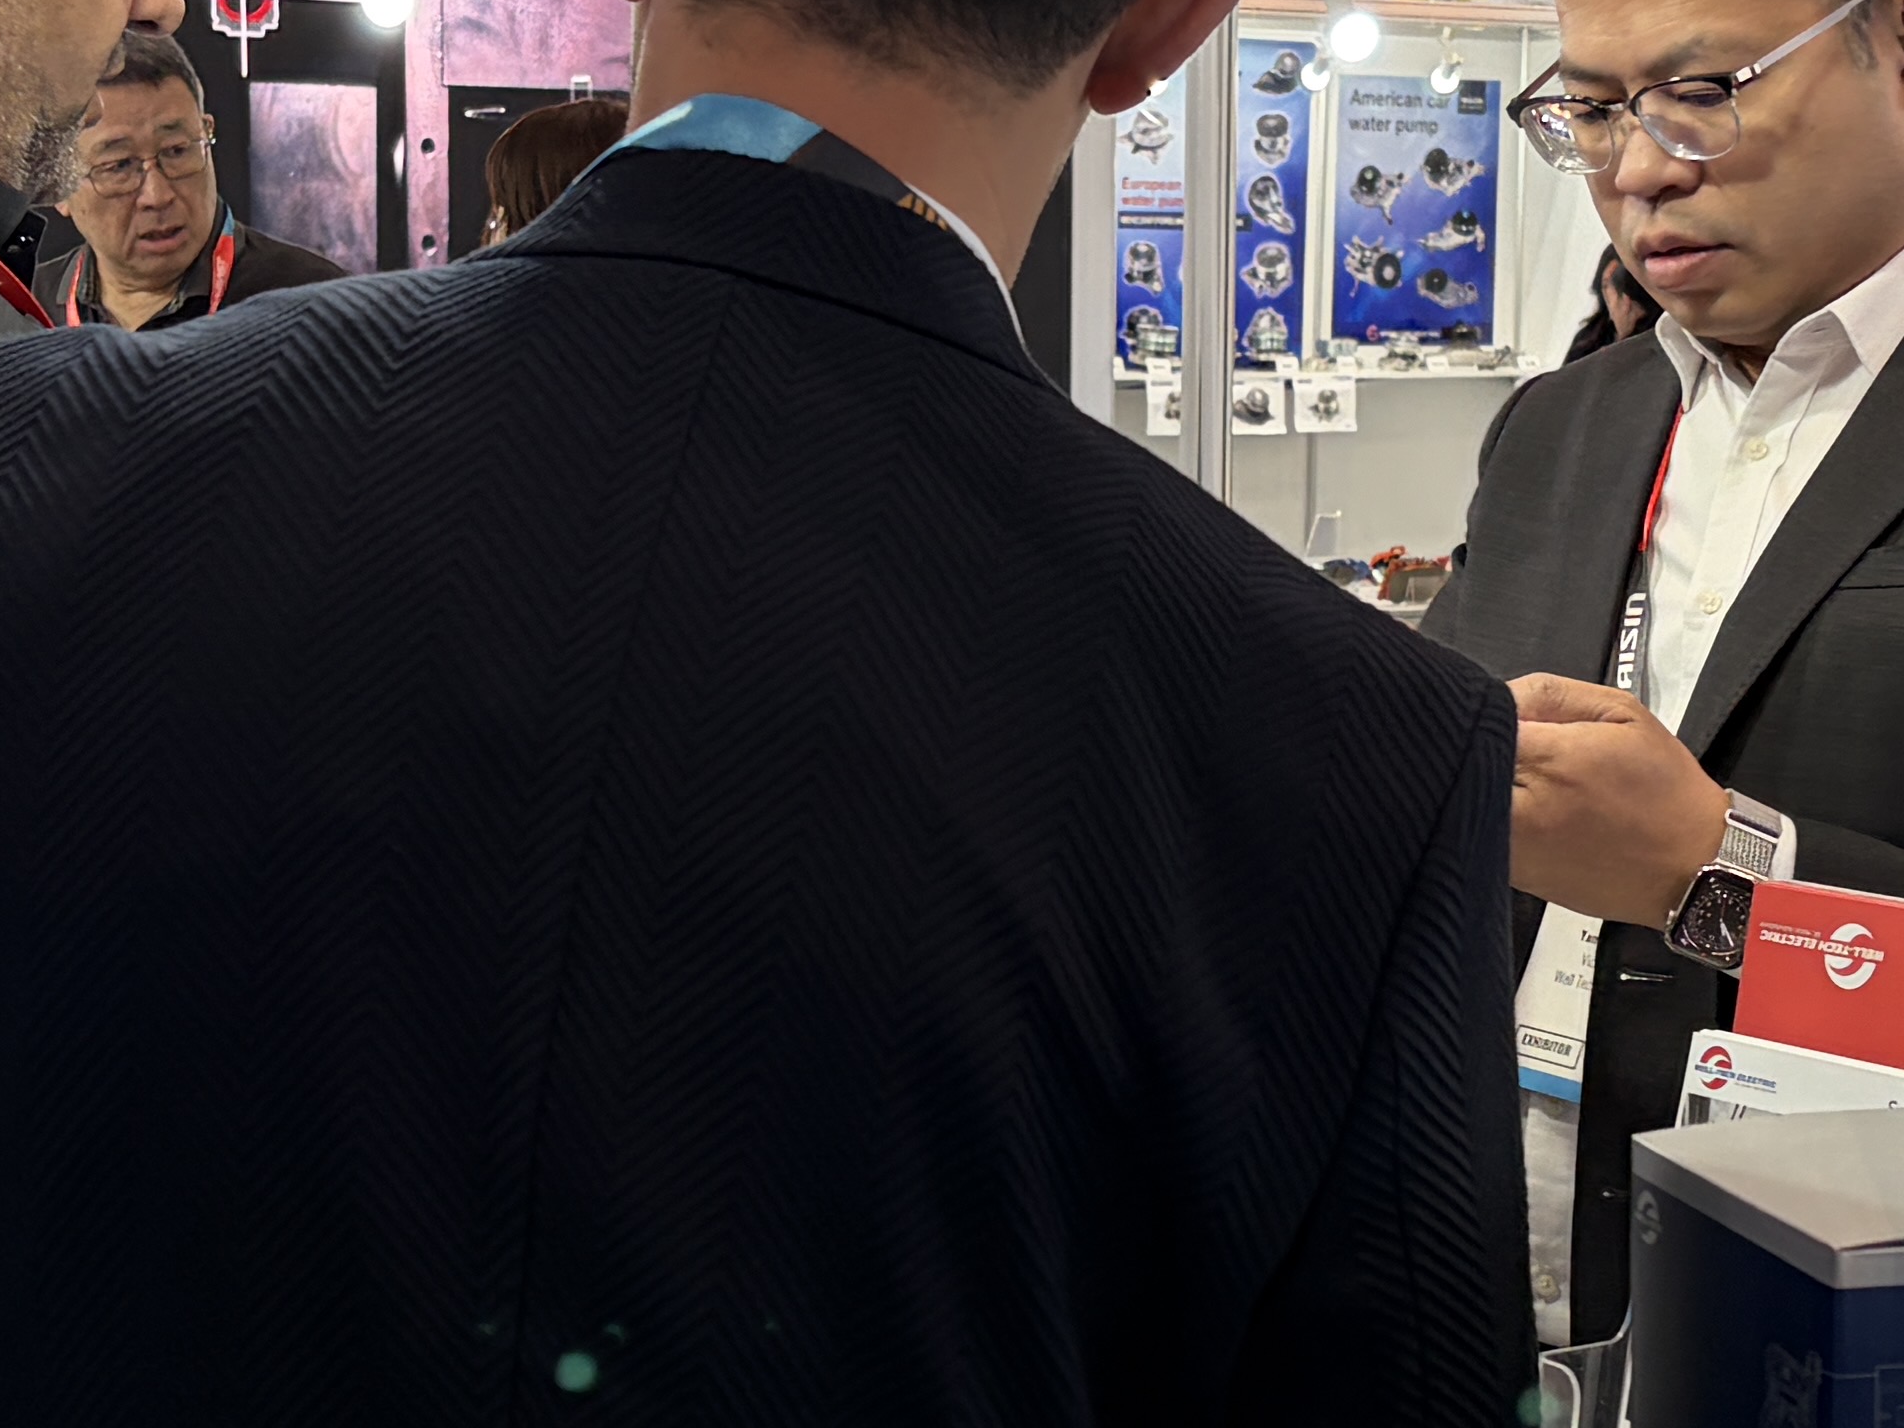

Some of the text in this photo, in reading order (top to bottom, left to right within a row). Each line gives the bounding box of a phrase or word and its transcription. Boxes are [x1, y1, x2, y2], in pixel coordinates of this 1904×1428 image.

[1350, 88, 1424, 108] American
[1426, 96, 1451, 109] car
[1348, 117, 1440, 137] water pump
[1759, 929, 1817, 950] ELECTRIC
